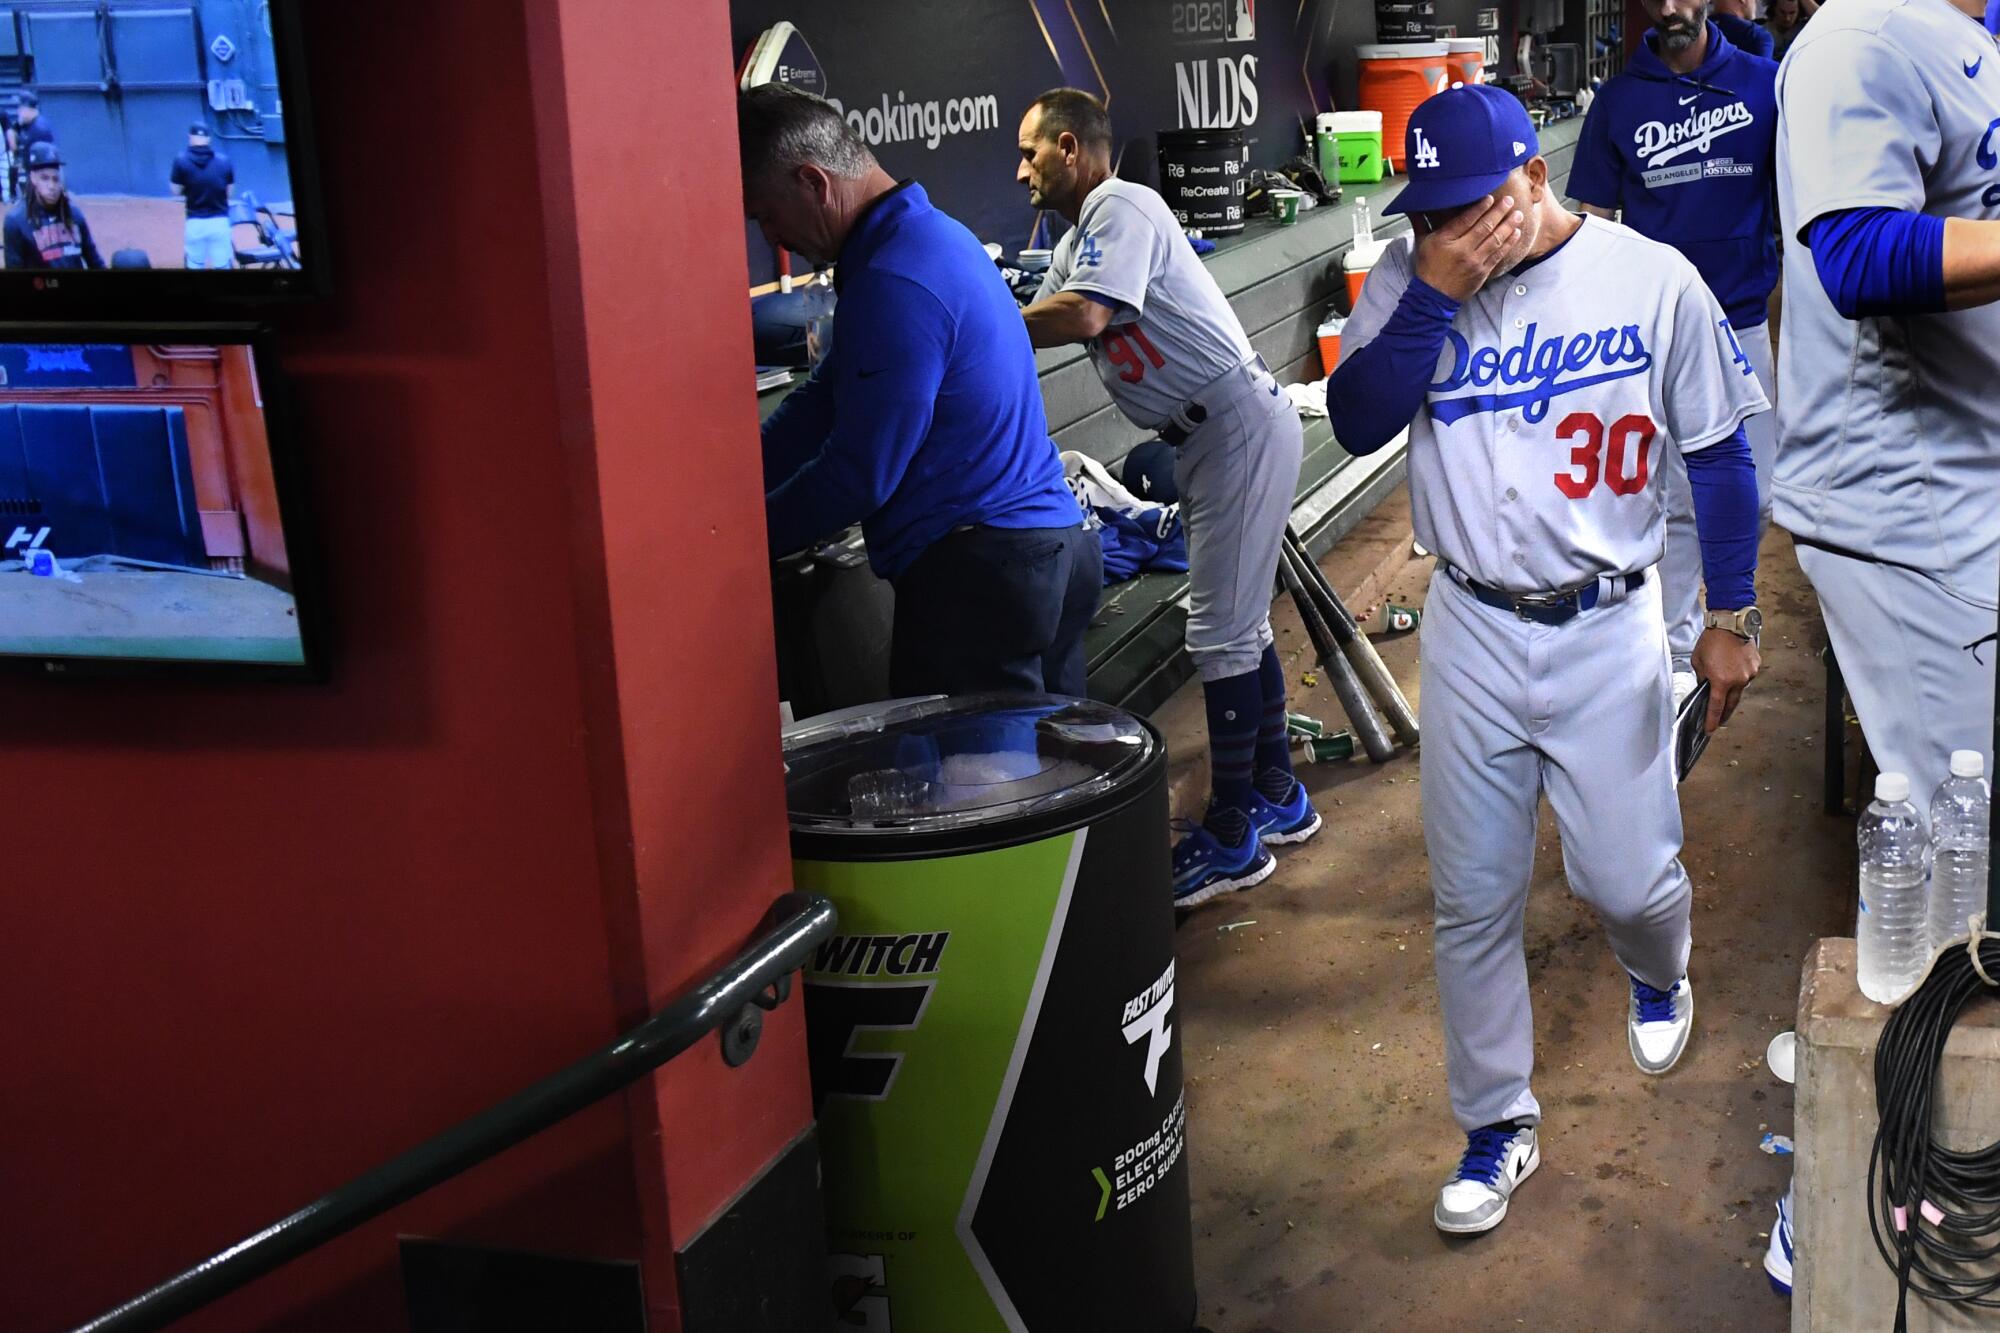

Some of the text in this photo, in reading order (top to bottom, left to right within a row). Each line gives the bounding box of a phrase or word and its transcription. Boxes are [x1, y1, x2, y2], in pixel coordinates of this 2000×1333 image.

[1172, 2, 1224, 33] 2023
[1175, 53, 1259, 129] NLDS
[1413, 127, 1440, 168] LA
[1634, 101, 1753, 160] Dodgers
[1180, 186, 1230, 197] ReCreate
[1647, 167, 1700, 183] LOS ANGELES
[1703, 164, 1753, 176] POSTSEASON
[1102, 321, 1166, 384] 91
[1554, 411, 1656, 500] 30
[801, 930, 951, 977] WITCH
[1121, 986, 1152, 1026] FAST
[1115, 1129, 1160, 1172] 200mg
[1116, 1105, 1186, 1190] ELECTROLYTE
[1117, 1135, 1183, 1210] ZERO SUGAR
[897, 1231, 917, 1241] OF
